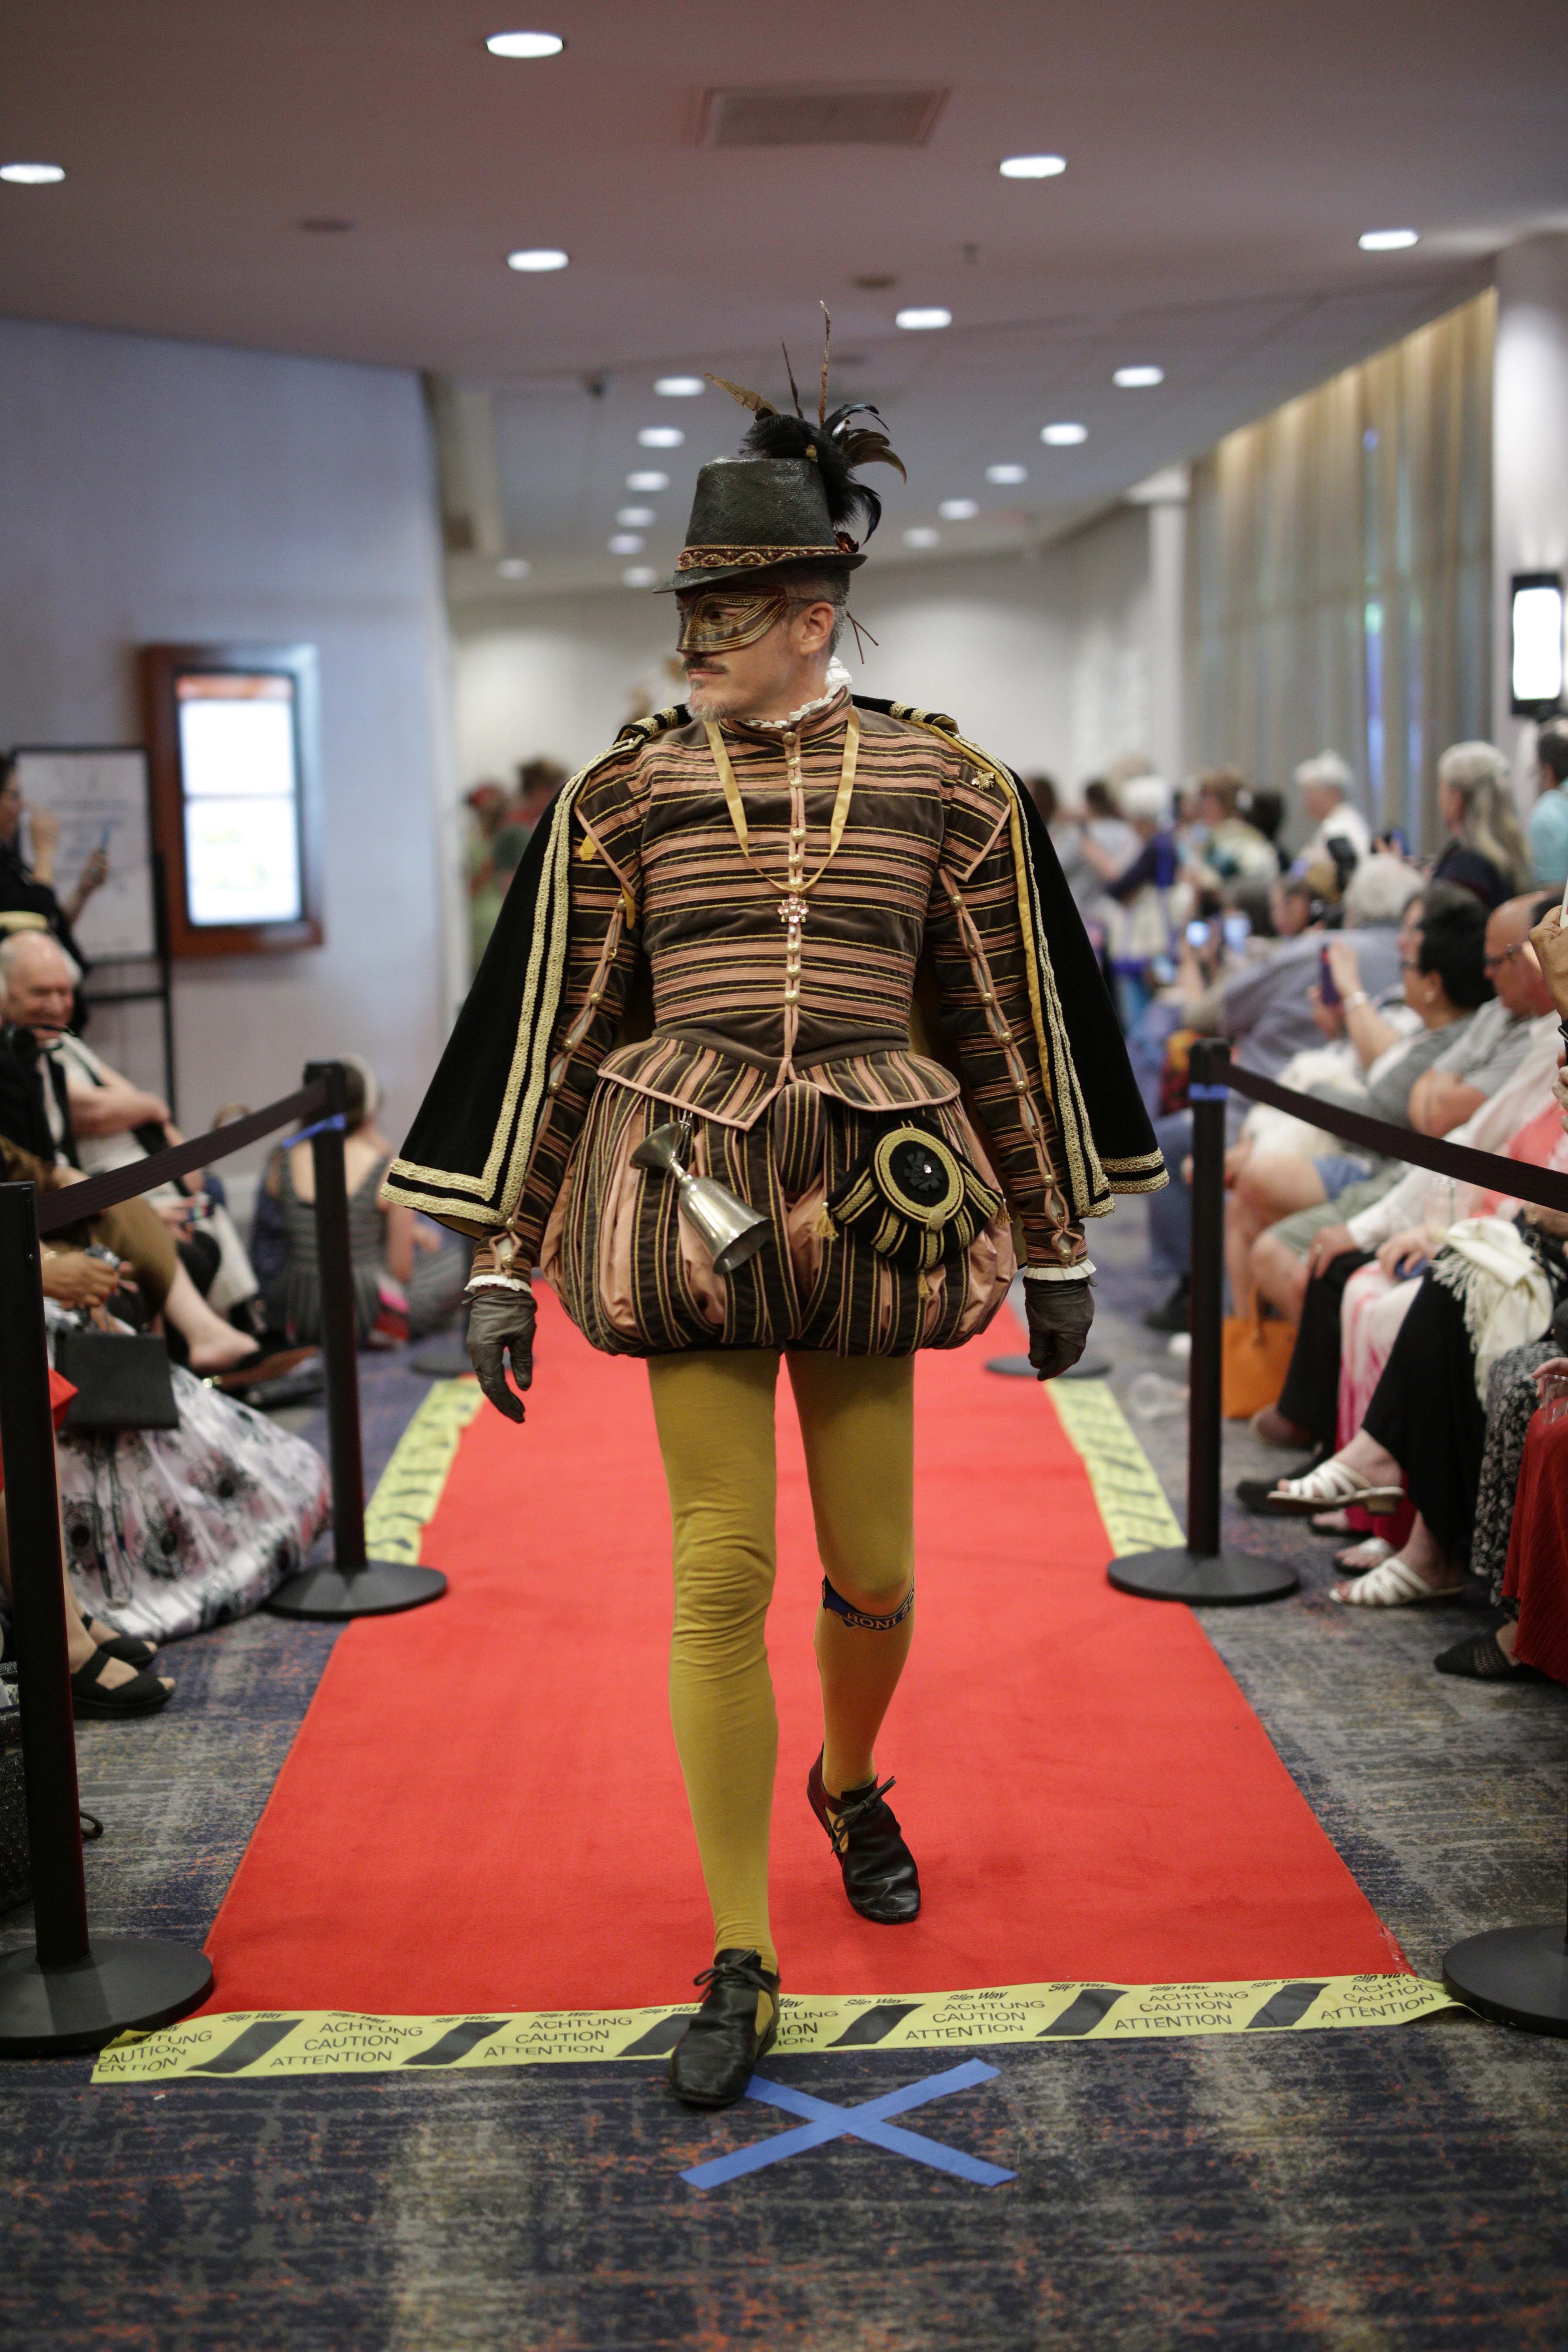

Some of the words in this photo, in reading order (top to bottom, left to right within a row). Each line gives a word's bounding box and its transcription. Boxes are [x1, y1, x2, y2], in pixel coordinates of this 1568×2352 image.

[1048, 1983, 1075, 1991] Slip
[978, 1991, 1008, 2000] Way
[1149, 1990, 1249, 2002] ACHTUNG
[944, 2000, 1045, 2011] ACHTUNG
[1139, 2000, 1232, 2012] CAUTION
[1321, 1993, 1435, 2020] ATTENTION
[223, 2014, 251, 2022] Slip
[780, 2010, 839, 2021] TUNG
[933, 2011, 1026, 2023] CAUTION
[319, 2022, 423, 2036] ACHTUNG
[529, 2017, 632, 2030] ACHTUNG
[1114, 2014, 1233, 2031] ATTENTION
[515, 2030, 609, 2044] CAUTION
[905, 2024, 1024, 2040] ATTENTION
[304, 2035, 399, 2051] CAUTION
[483, 2044, 604, 2058] ATTENTION
[270, 2051, 392, 2068] ATTENTION
